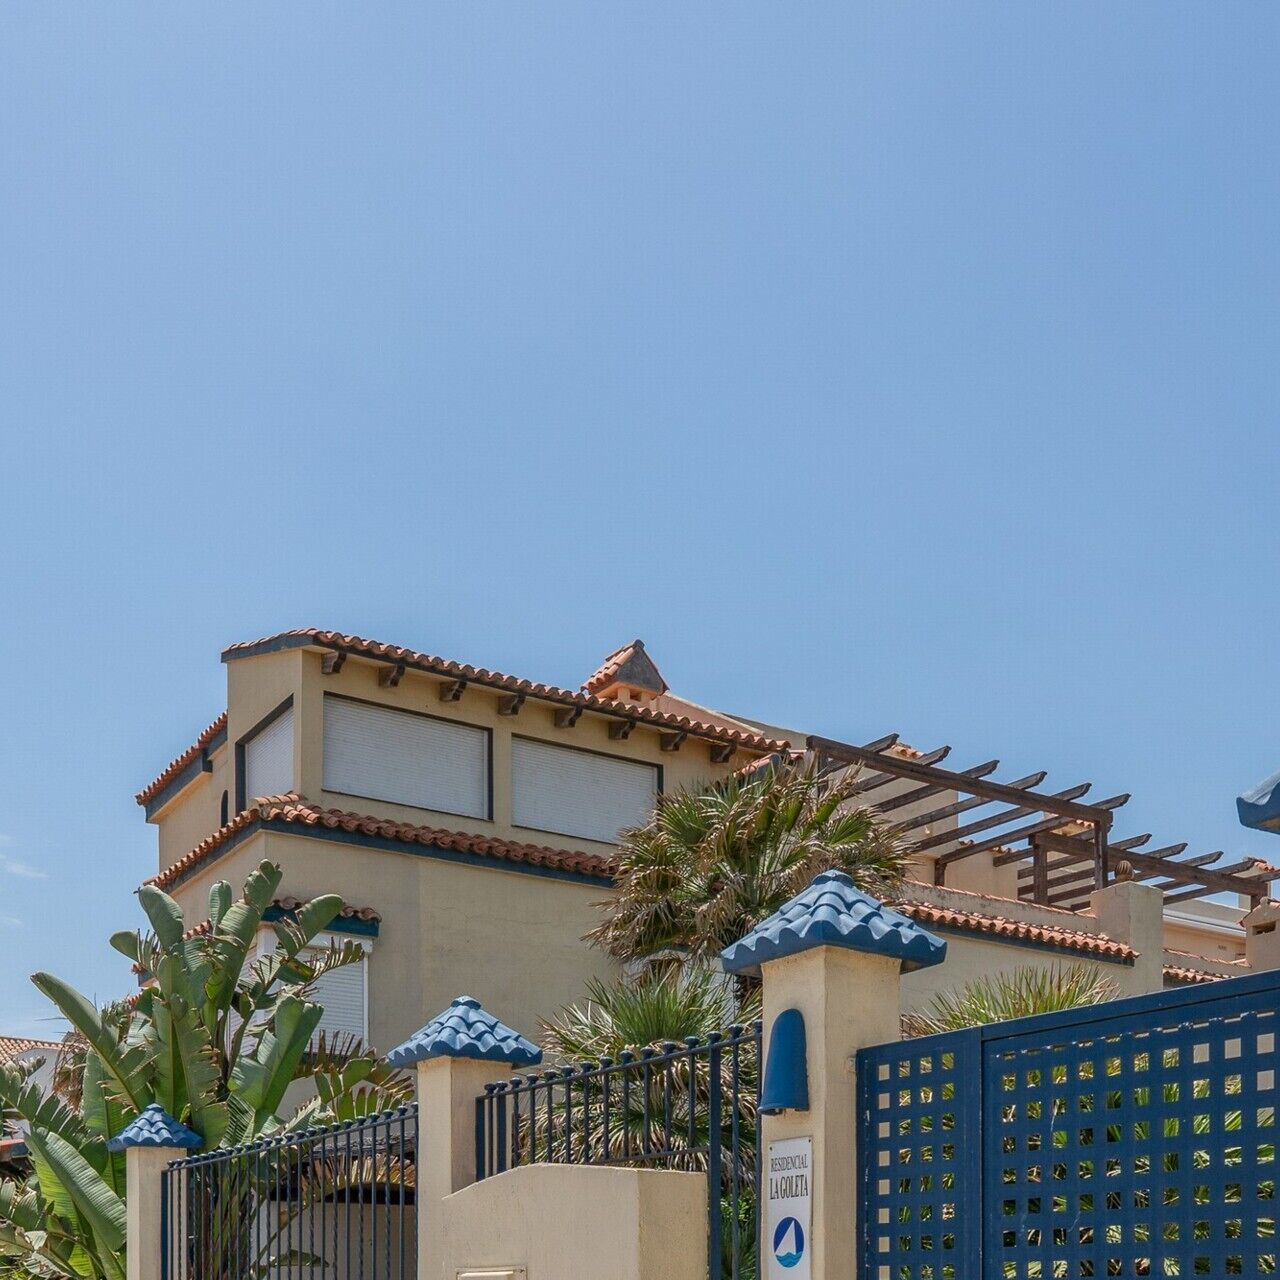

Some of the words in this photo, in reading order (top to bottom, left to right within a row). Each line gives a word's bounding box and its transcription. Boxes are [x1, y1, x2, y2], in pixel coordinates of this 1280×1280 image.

[771, 1154, 808, 1172] RESIDENCIAL
[770, 1178, 779, 1200] LA
[780, 1174, 808, 1199] GOLETA
